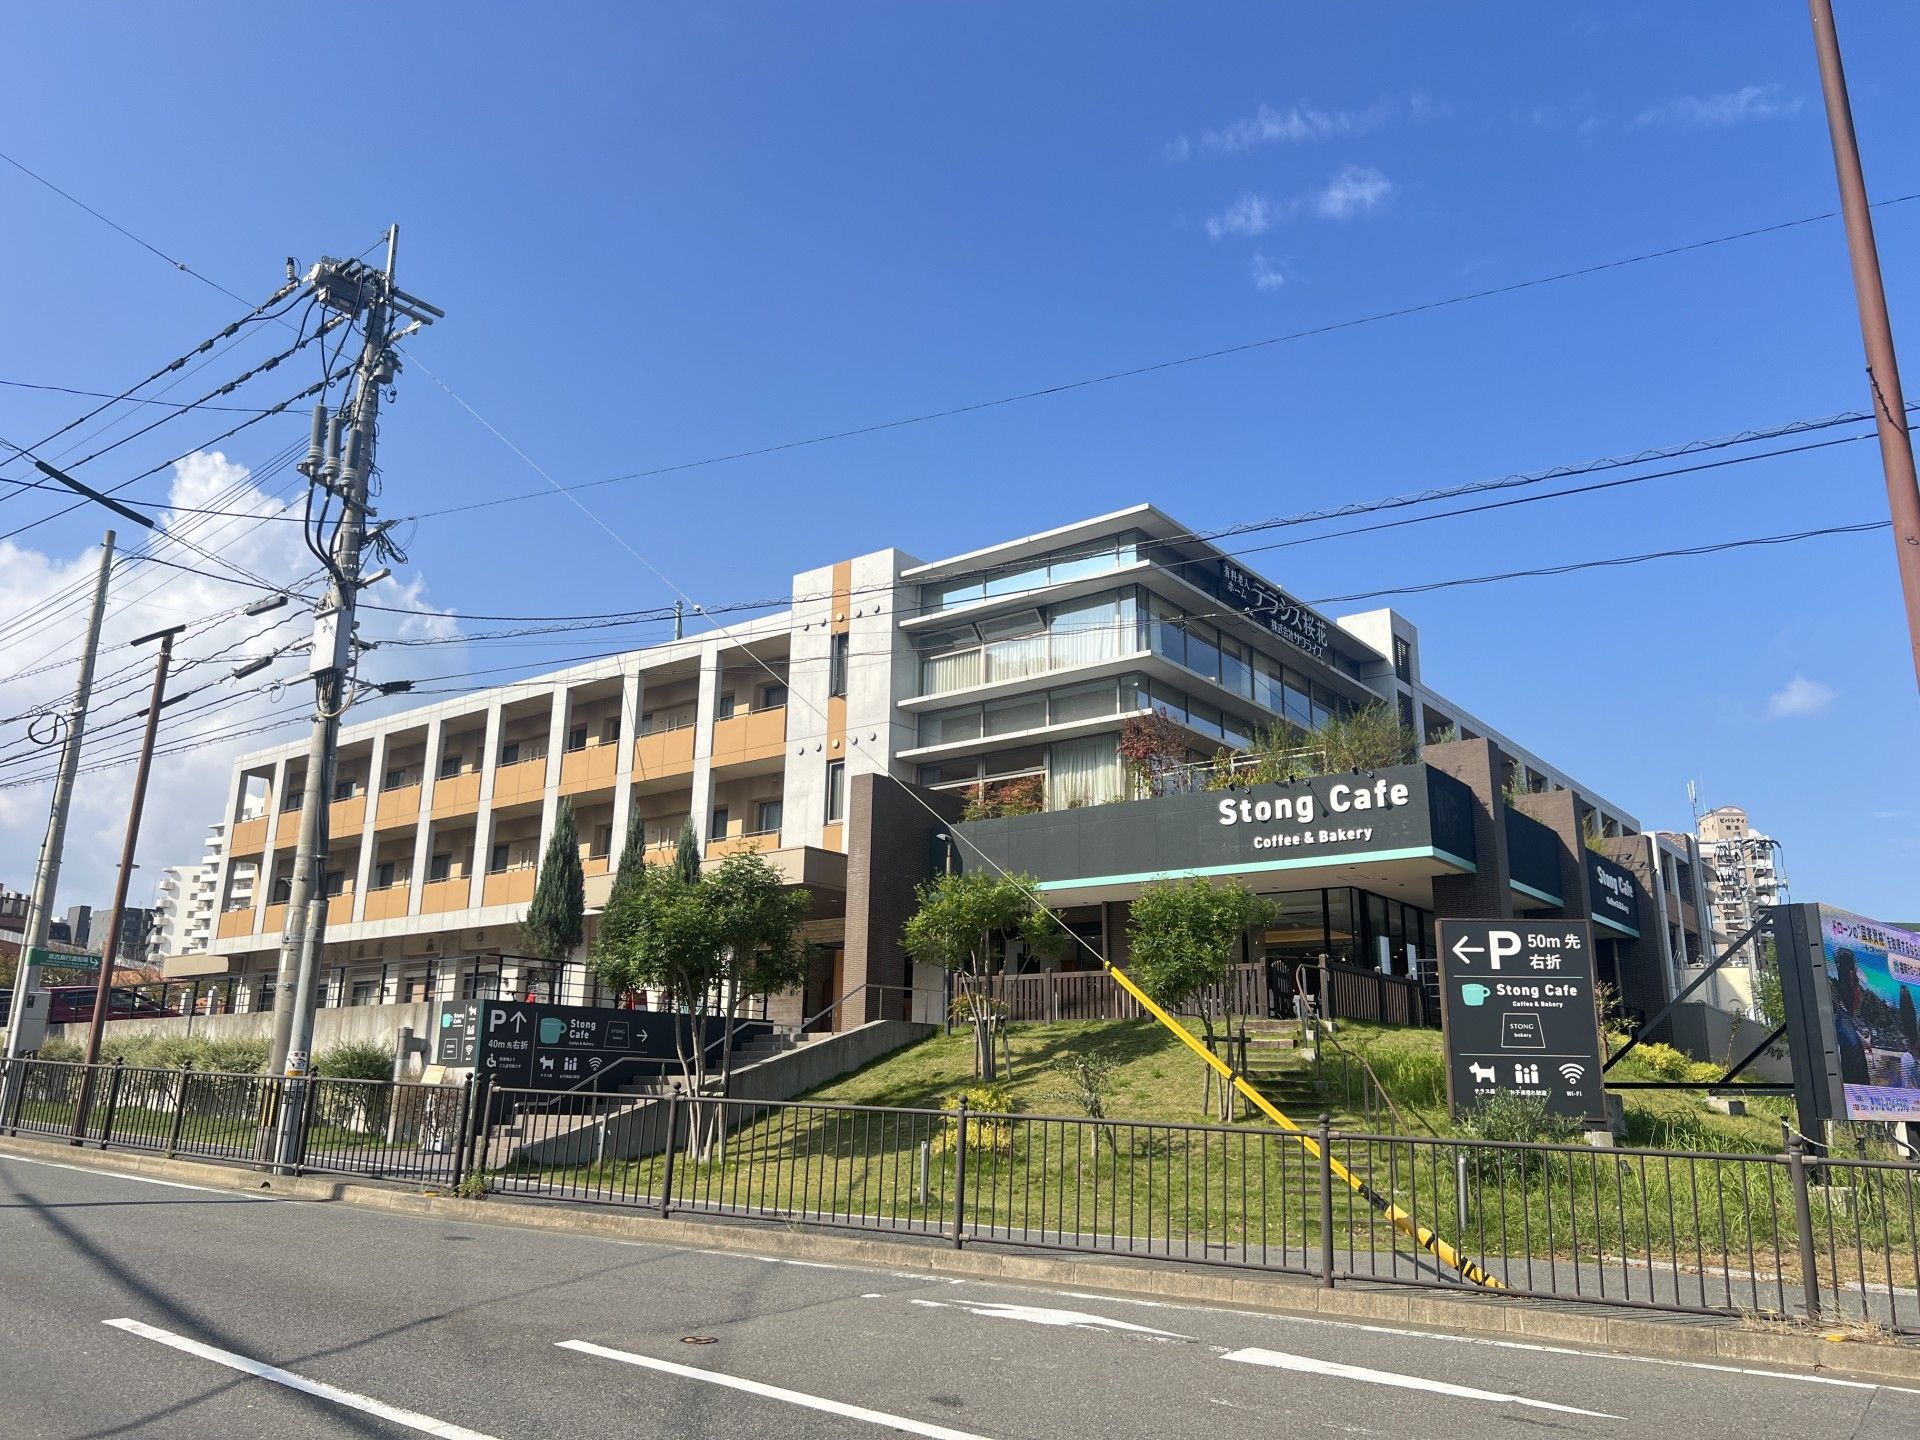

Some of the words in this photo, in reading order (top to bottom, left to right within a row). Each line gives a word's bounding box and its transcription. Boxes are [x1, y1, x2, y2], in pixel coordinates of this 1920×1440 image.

[1219, 795, 1314, 826] Stong
[1329, 779, 1409, 813] Cafe
[1254, 834, 1300, 849] Coffee
[1303, 832, 1315, 844] &
[1318, 827, 1373, 844] Bakery
[1489, 930, 1521, 969] P
[1527, 934, 1560, 948] 50m
[1565, 933, 1581, 949] 先
[1529, 954, 1561, 970] 右折
[1496, 983, 1539, 998] Stong
[1545, 983, 1578, 996] Cafe
[489, 1009, 507, 1033] P
[570, 1019, 596, 1030] Stong
[569, 1030, 590, 1039] Cafe
